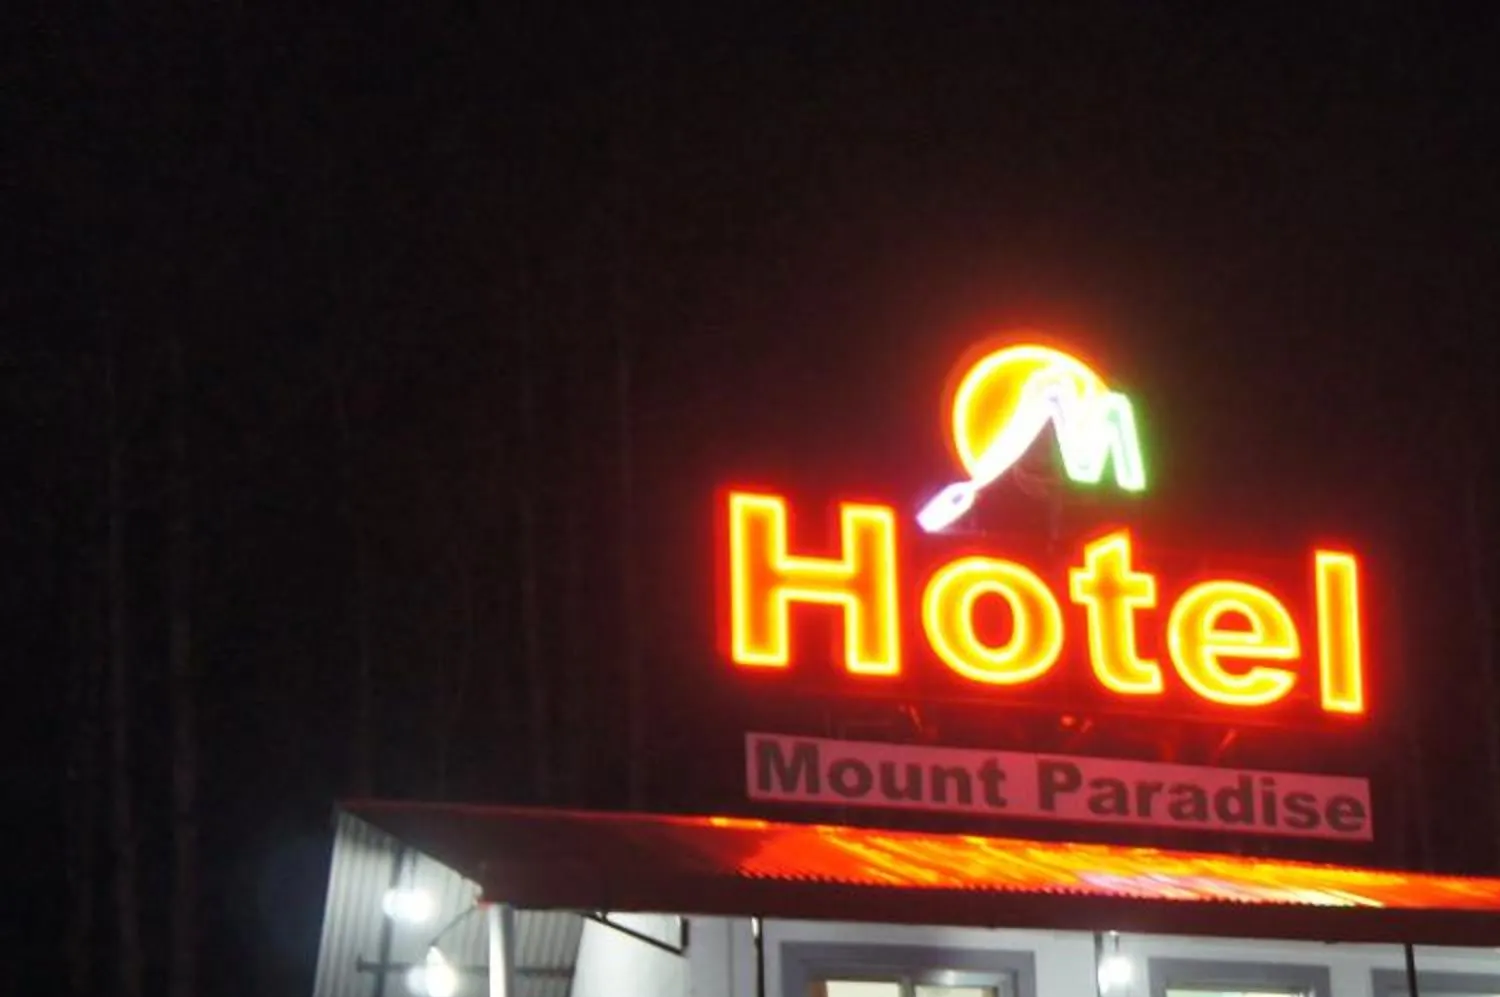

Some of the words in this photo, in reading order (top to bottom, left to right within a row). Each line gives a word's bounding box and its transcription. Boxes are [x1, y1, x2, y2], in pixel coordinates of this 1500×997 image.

[729, 492, 1365, 714] Hotel
[755, 740, 1007, 807] Mount
[1037, 760, 1367, 834] Paradise
